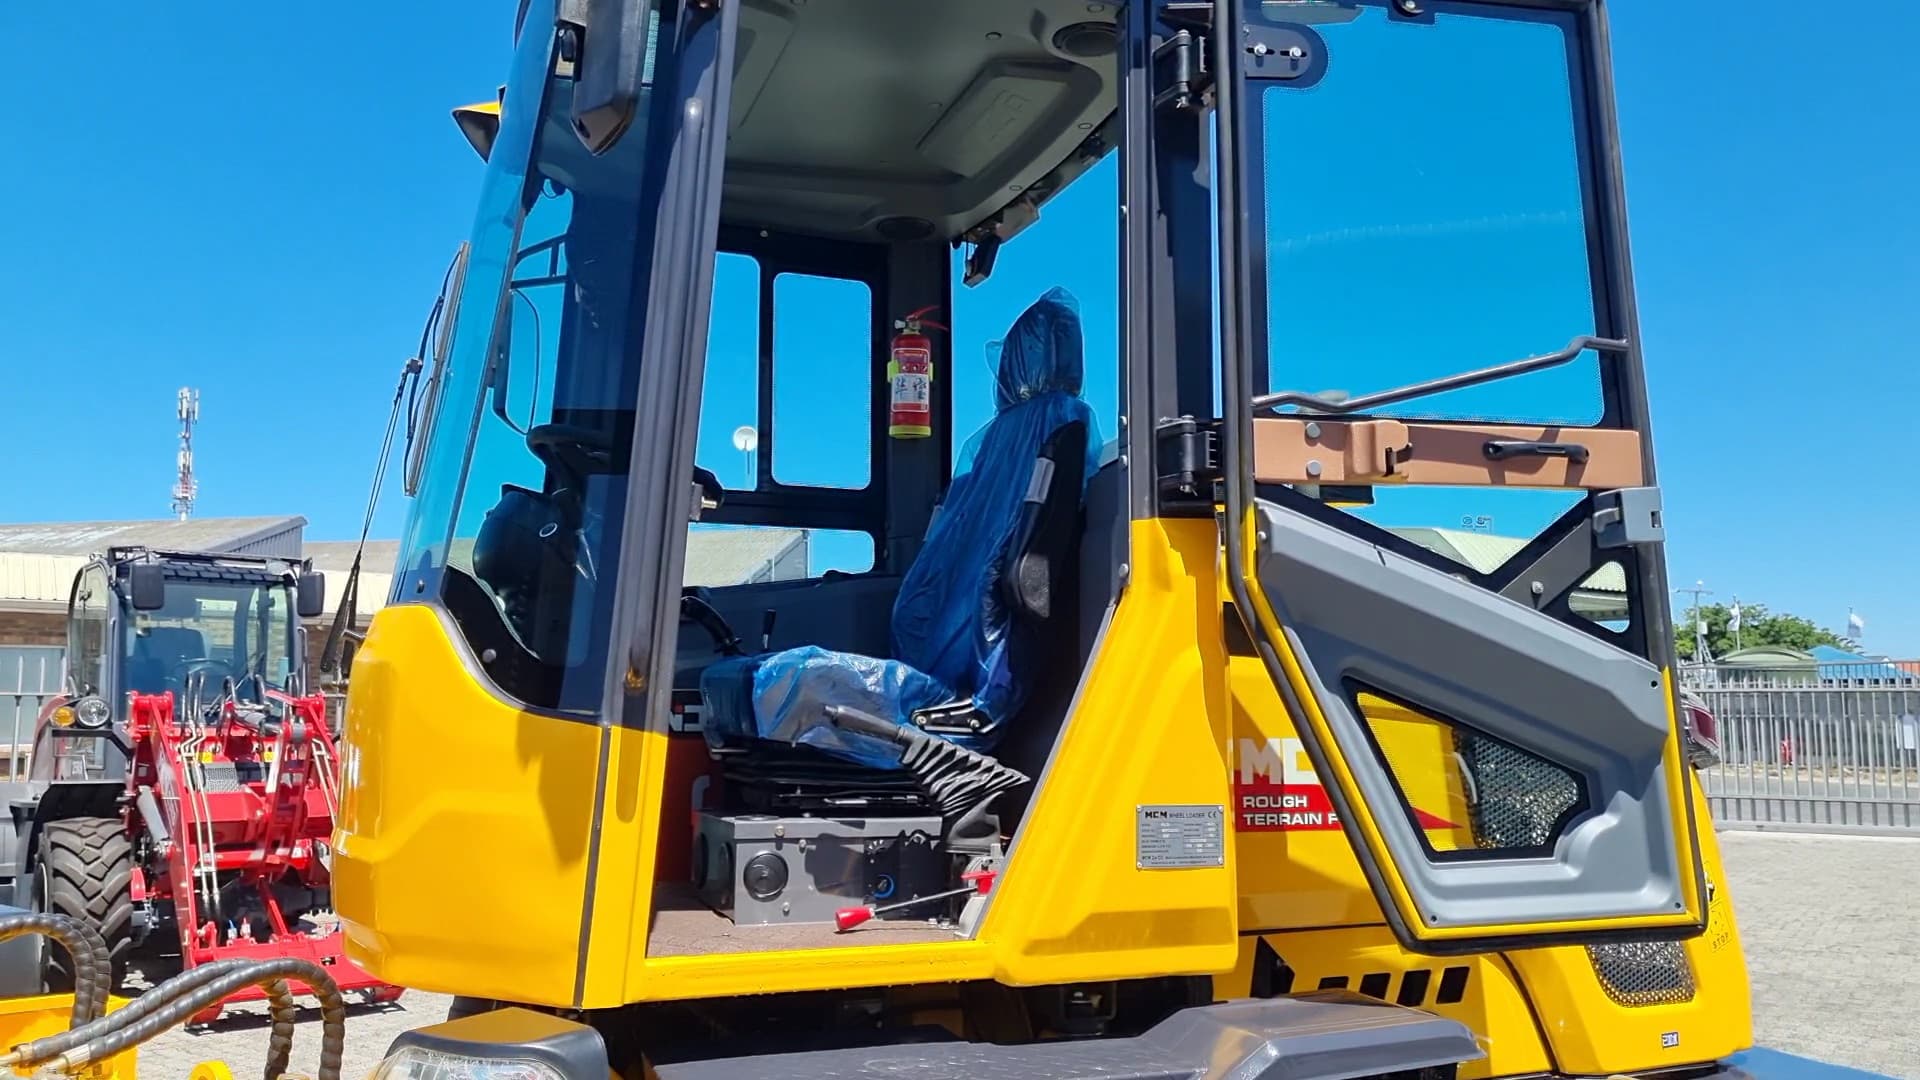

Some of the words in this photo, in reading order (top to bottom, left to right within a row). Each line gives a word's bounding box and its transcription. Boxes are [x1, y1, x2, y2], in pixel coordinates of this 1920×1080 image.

[1242, 795, 1308, 808] ROUGH
[1145, 811, 1167, 819] MCM
[1242, 813, 1323, 826] TERRAIN
